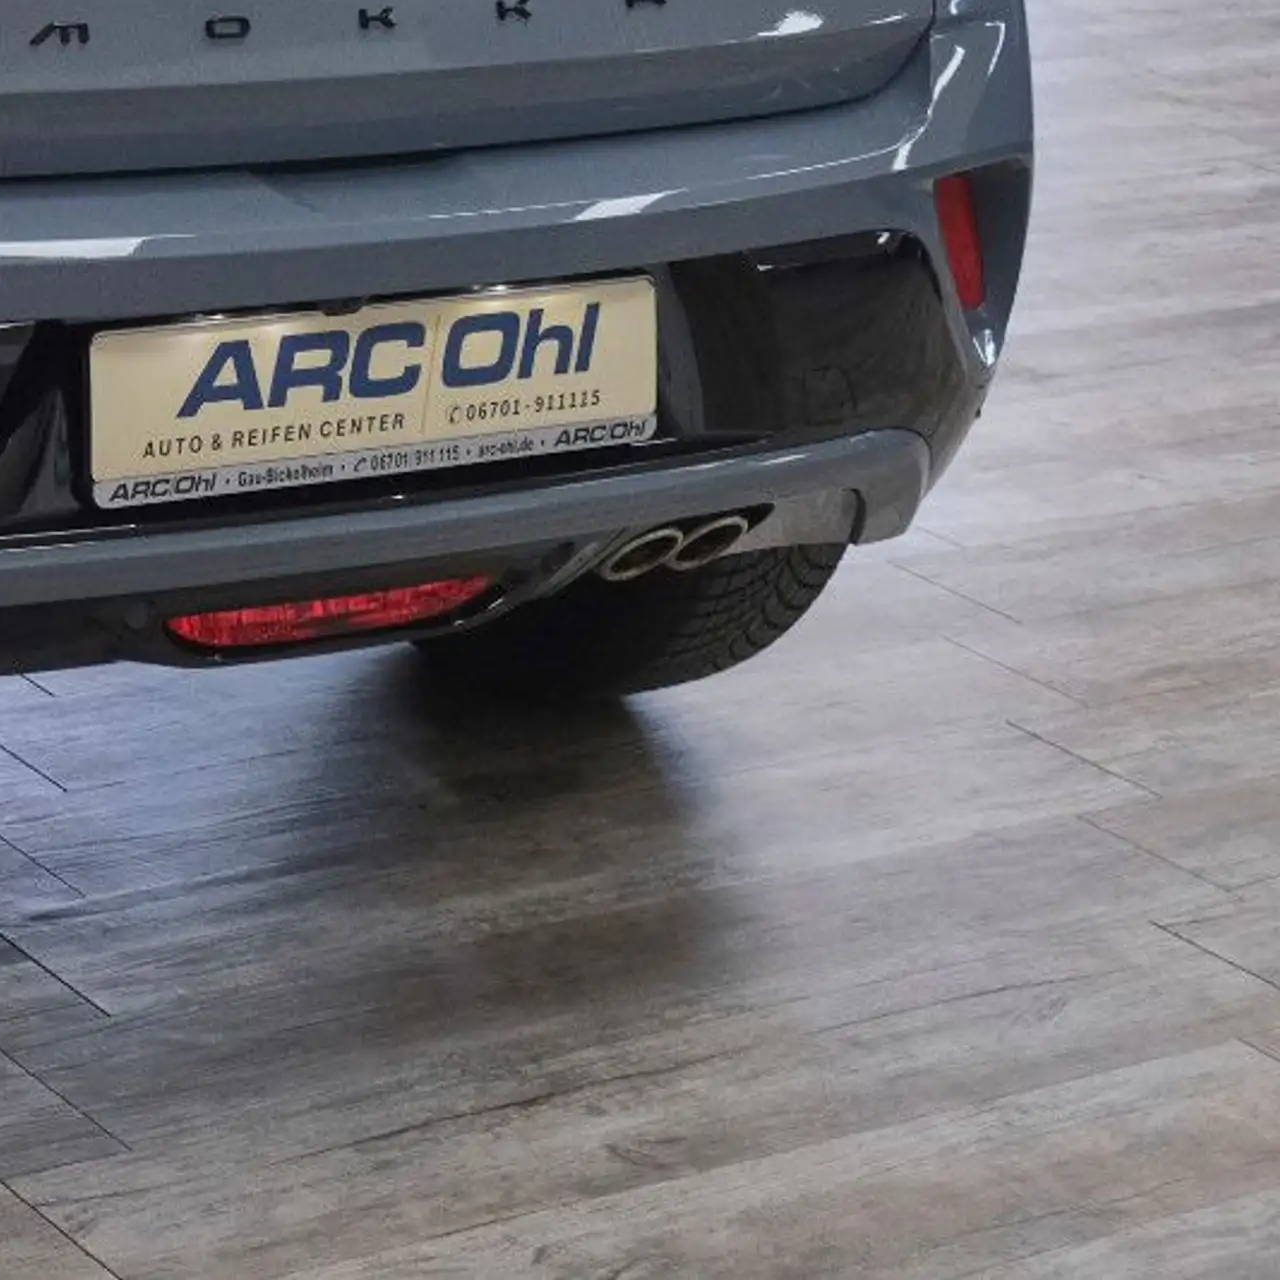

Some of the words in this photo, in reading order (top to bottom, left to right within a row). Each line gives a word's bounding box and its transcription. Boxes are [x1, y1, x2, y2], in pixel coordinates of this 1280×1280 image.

[465, 389, 601, 421] 06701-911115
[142, 436, 204, 459] AUTO
[211, 433, 224, 452] &
[231, 423, 311, 449] REIFEN
[319, 413, 406, 439] CENTER
